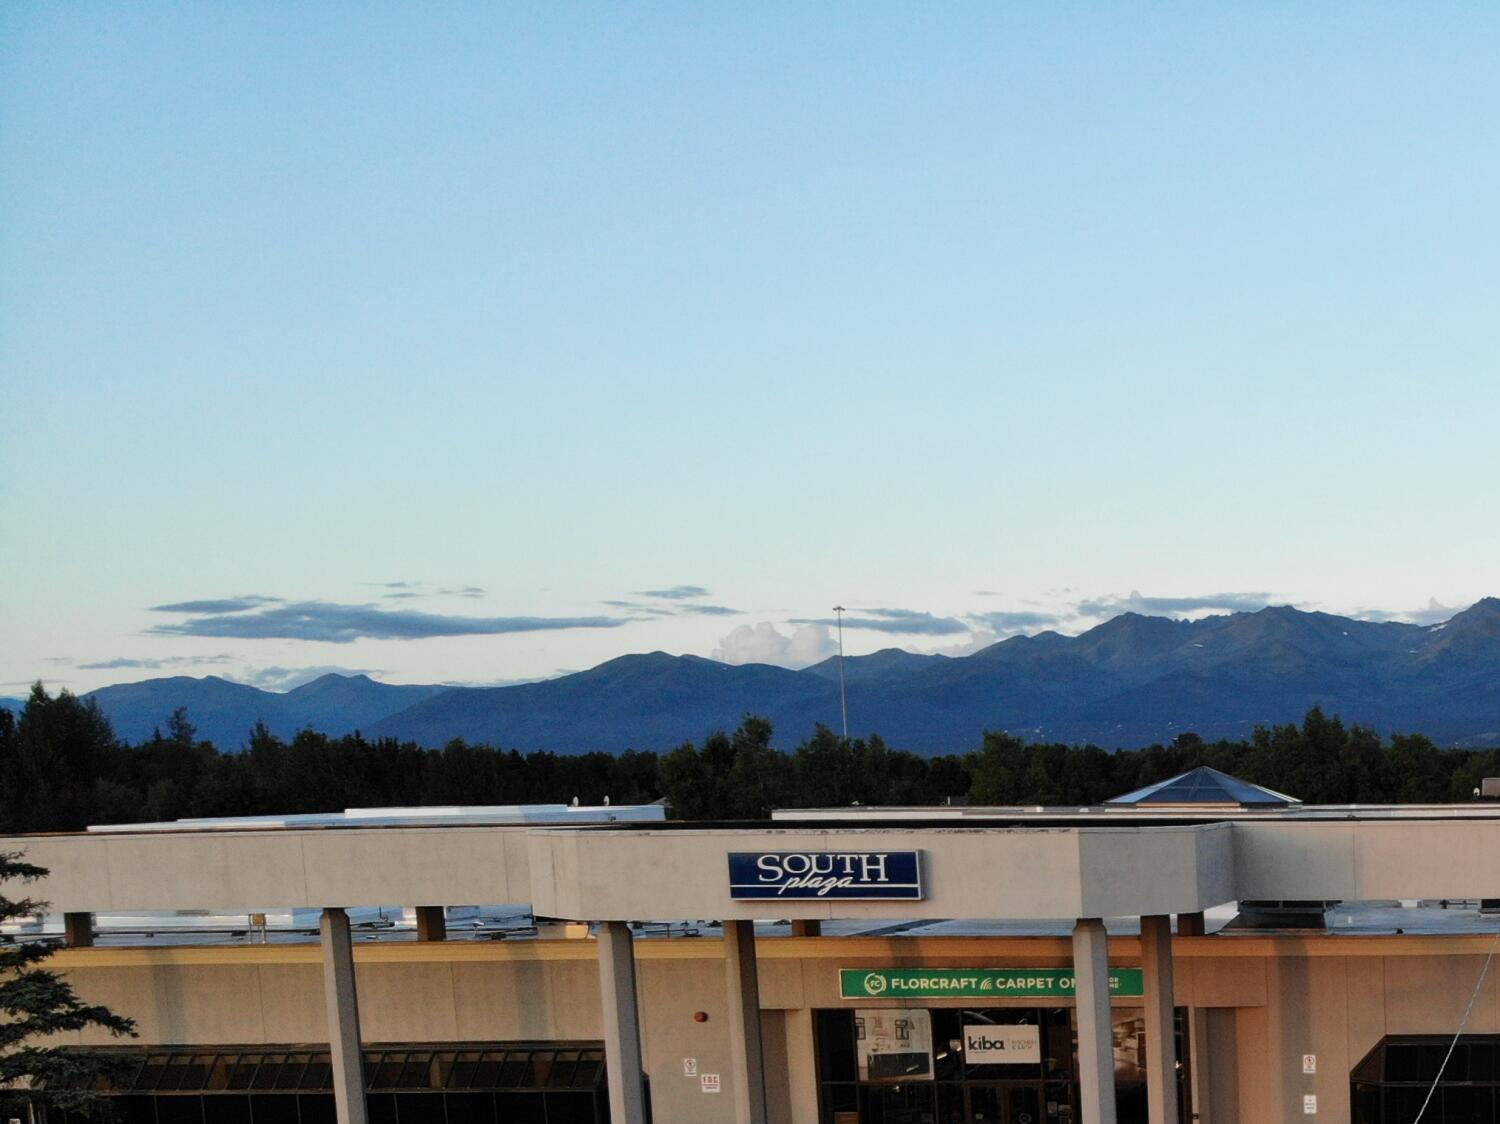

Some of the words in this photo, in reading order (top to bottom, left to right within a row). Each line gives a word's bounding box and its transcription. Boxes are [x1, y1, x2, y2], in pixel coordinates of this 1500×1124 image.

[757, 854, 888, 882] SOUTH
[778, 870, 853, 895] plaza
[891, 978, 978, 989] FLORCRAFT
[996, 978, 1054, 989] CARPET
[968, 1035, 1005, 1050] kiba
